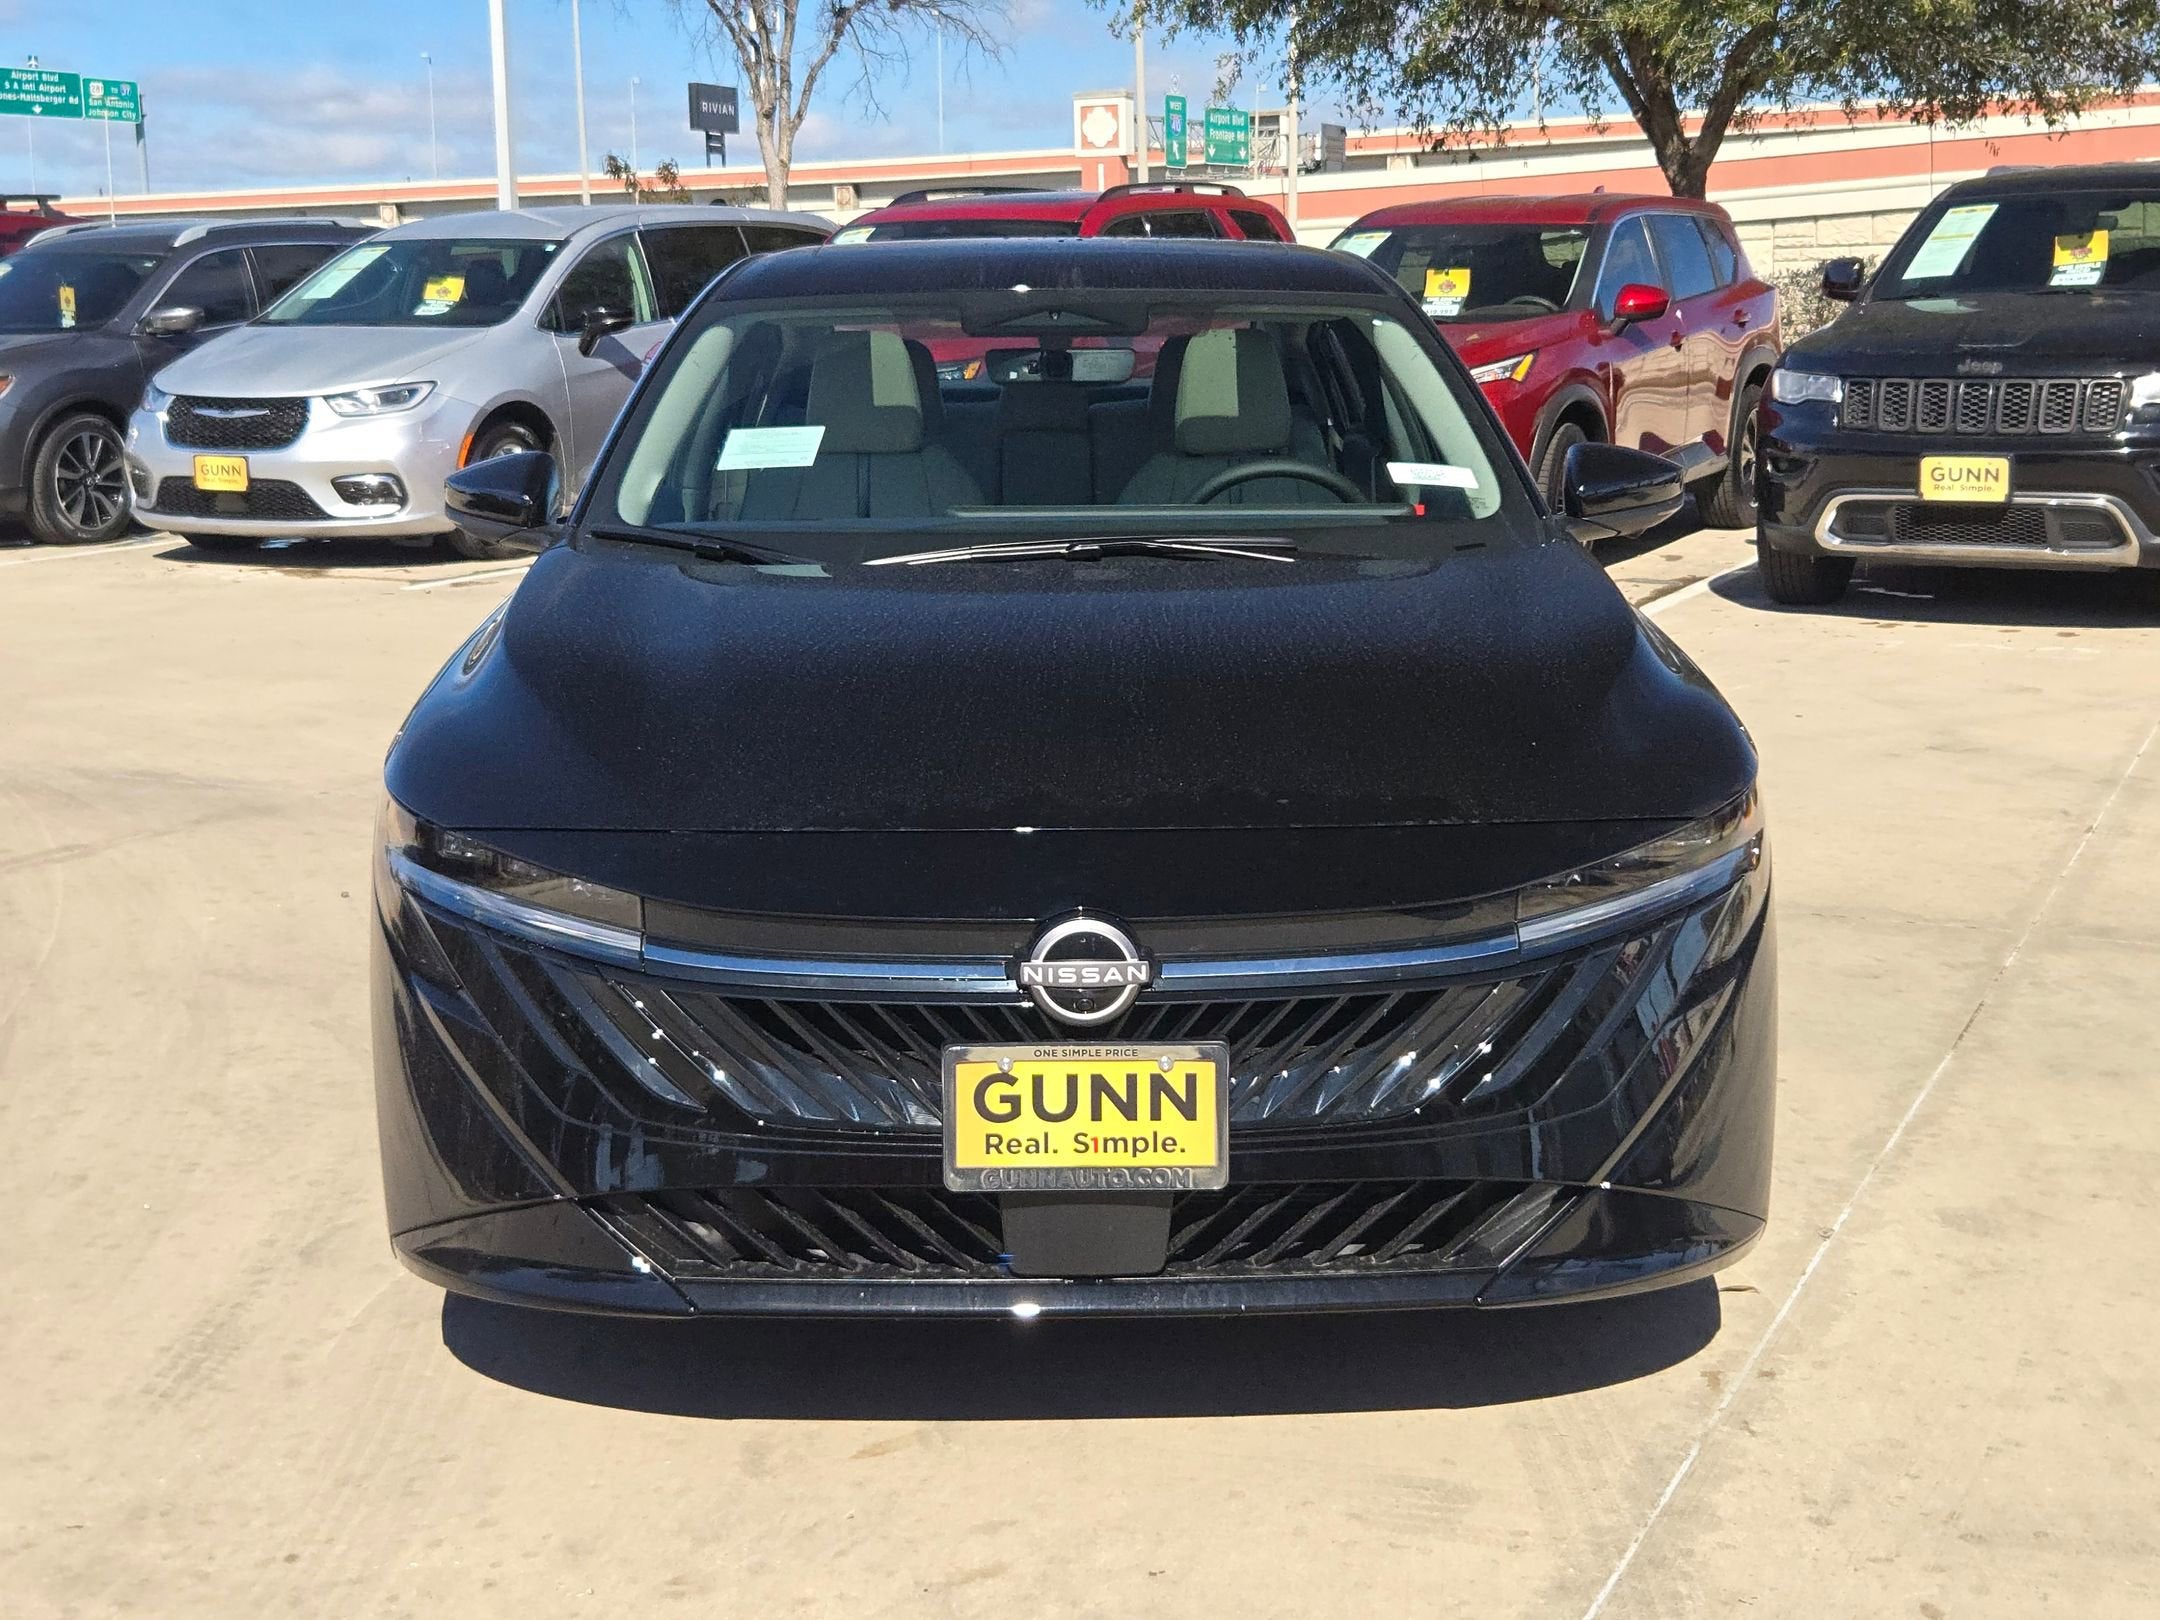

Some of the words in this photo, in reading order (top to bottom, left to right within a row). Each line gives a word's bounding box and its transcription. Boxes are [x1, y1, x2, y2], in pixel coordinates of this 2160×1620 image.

[11, 70, 39, 80] Airport
[42, 73, 59, 82] Blvd
[4, 80, 11, 90] S
[13, 81, 19, 90] A
[39, 83, 66, 94] Airport
[68, 96, 79, 105] Rd
[89, 98, 103, 106] San
[1169, 101, 1182, 111] WEST
[121, 110, 136, 121] City
[702, 101, 735, 117] RIVIAN
[1209, 112, 1230, 126] Airport
[1231, 114, 1245, 126] Blvd
[1209, 127, 1235, 143] Frontage
[1236, 130, 1245, 142] Rd
[1957, 359, 2003, 374] Jeep
[200, 463, 242, 477] GUNN
[1930, 466, 2000, 483] GUNN
[1023, 964, 1147, 984] NISSAN
[1033, 1048, 1058, 1058] ONE
[1061, 1048, 1102, 1057] SIMPLE
[1105, 1048, 1139, 1057] PRICE
[973, 1072, 1198, 1124] GUNN
[985, 1131, 1059, 1155] Real.
[980, 1167, 1193, 1189] GUNNAUTO.COM
